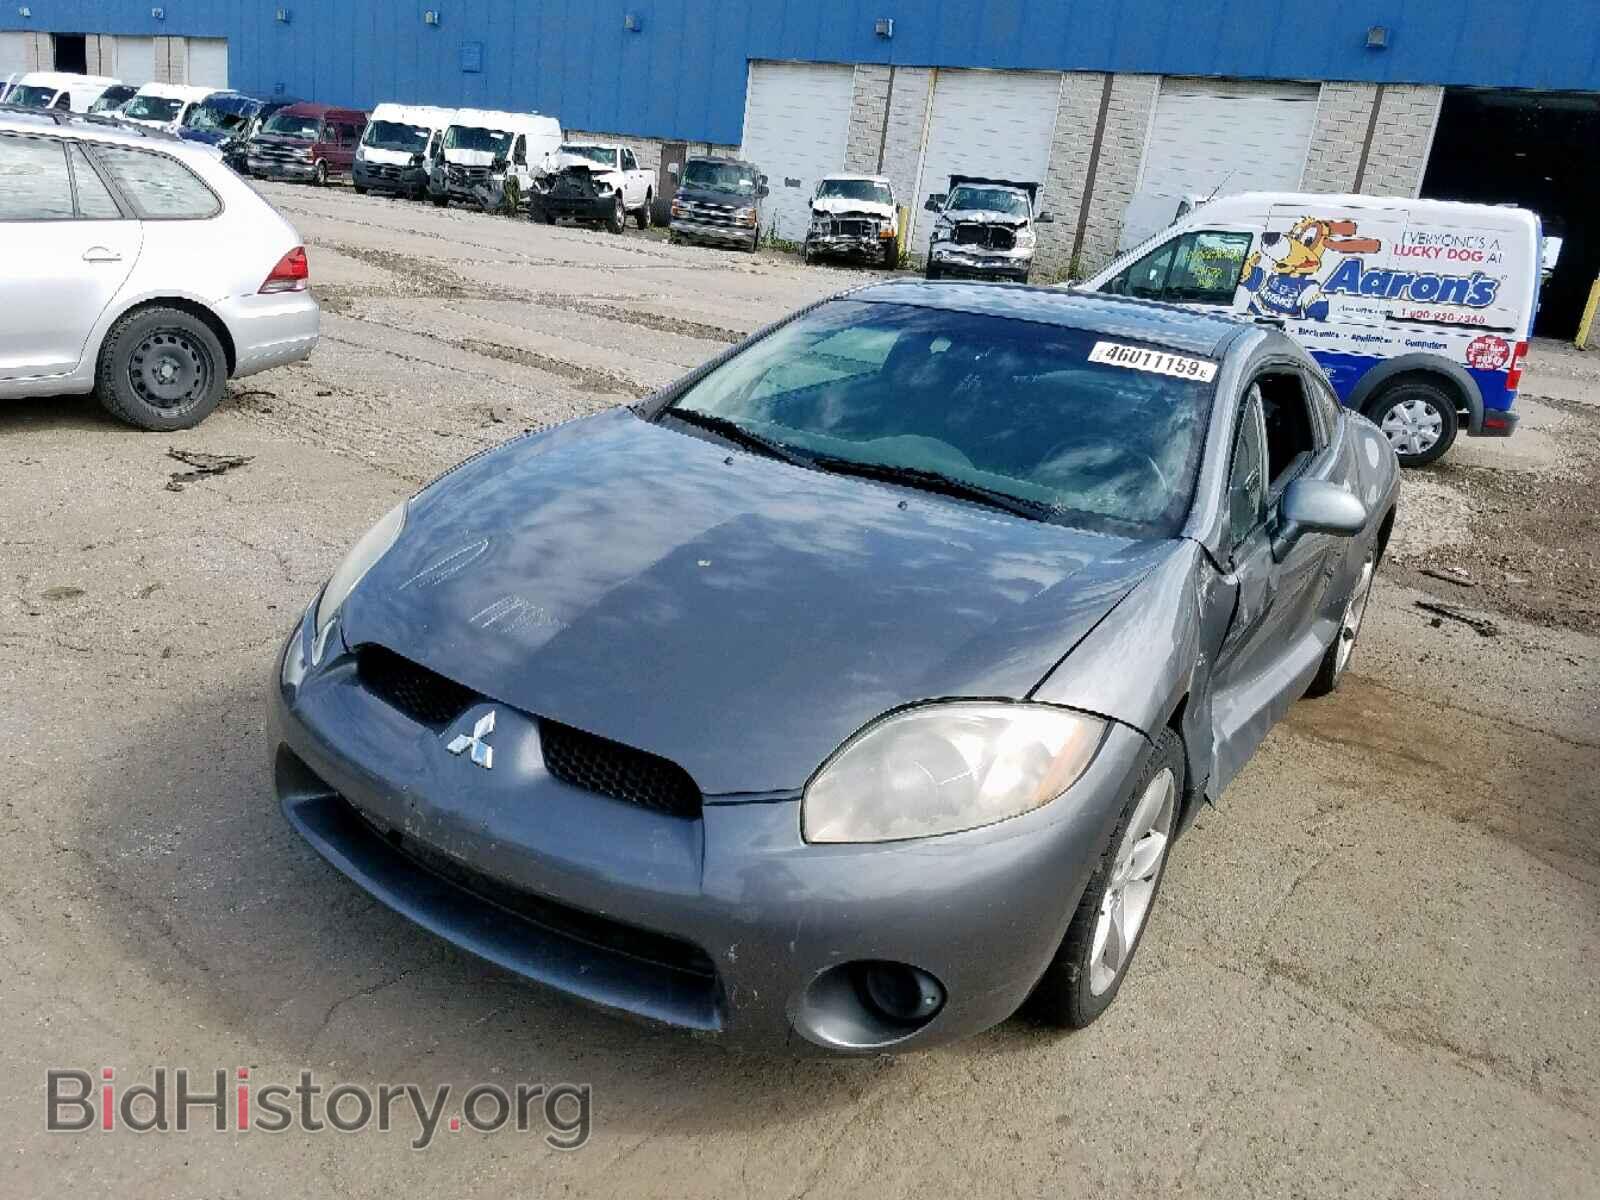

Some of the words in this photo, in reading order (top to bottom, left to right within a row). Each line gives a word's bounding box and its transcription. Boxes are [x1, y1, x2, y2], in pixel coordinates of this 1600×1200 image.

[1393, 242, 1443, 259] LUCKY
[1447, 247, 1485, 262] DOG
[1320, 256, 1502, 308] Aaron's
[1404, 336, 1449, 351] Computers
